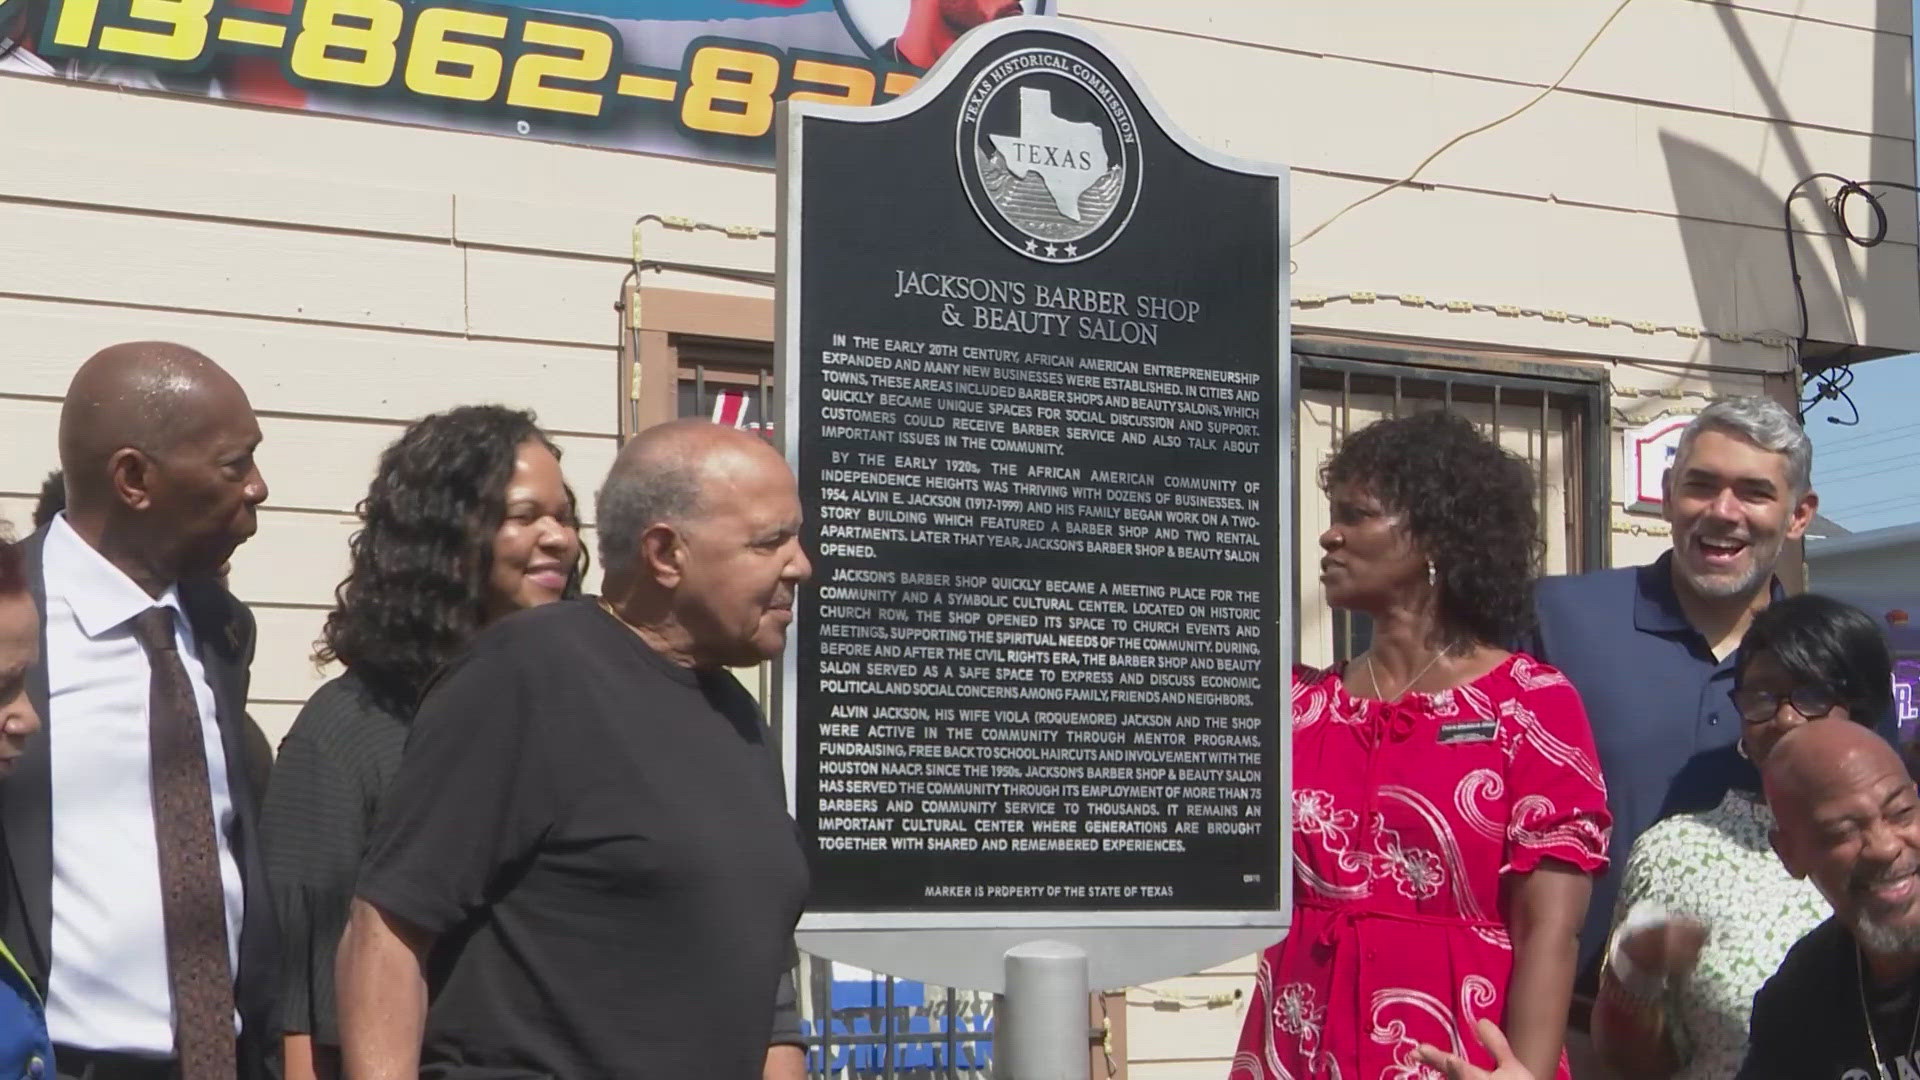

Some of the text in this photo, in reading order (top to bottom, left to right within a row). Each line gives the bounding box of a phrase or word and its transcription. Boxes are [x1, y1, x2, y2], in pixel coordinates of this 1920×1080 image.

[965, 54, 1135, 144] TEXAS HISTORICAL COMMISSION
[1012, 142, 1092, 171] TEXAS
[895, 270, 1200, 323] JACKSON'S BARBER SHOP
[941, 303, 1158, 346] & BEAUTY SALON
[832, 333, 846, 348] IN
[853, 335, 879, 351] THE
[884, 338, 924, 355] EARLY
[928, 342, 958, 358] 20TH
[1025, 351, 1074, 368] AFRICAN
[1079, 357, 1138, 374] AMERICAN
[1143, 363, 1259, 384] ENTREPRENEURSHIP
[822, 351, 892, 370] EXPANDED
[894, 358, 921, 372] AND
[923, 360, 959, 376] MANY
[962, 364, 990, 378] NEW
[993, 367, 1063, 385] BUSINESSES
[1066, 373, 1100, 388] WERE
[1185, 384, 1197, 397] IN
[1199, 386, 1233, 400] CITIES
[1236, 389, 1259, 402] AND
[821, 406, 1258, 453] CUSTOMERS COULD RECEIVE BARBER SERVICE AND ALSO TALK ABOUT
[821, 425, 893, 443] IMPORTANT
[898, 431, 940, 447] ISSUES
[944, 435, 957, 448] IN
[962, 436, 986, 450] THE
[831, 450, 849, 465] BY
[859, 452, 885, 467] THE
[894, 455, 937, 471] EARLY
[991, 462, 1017, 476] THE
[1027, 465, 1081, 481] AFRICAN
[1090, 469, 1154, 486] AMERICAN
[1164, 475, 1236, 492] COMMUNITY
[1244, 480, 1260, 493] OF
[821, 469, 921, 488] INDEPENDENCE
[925, 476, 979, 492] HEIGHTS
[983, 480, 1008, 494] WAS
[1014, 482, 1067, 498] THRIVING
[1072, 486, 1102, 500] WITH
[1106, 489, 1151, 503] DOZENS
[1155, 492, 1170, 505] OF
[1248, 498, 1259, 510] IN
[832, 569, 1260, 602] JACKSON'S BARBER SHOP QUICKLY BECAME A MEETING PLACE FOR THE
[819, 605, 871, 620] CHURCH
[917, 610, 941, 623] THE
[948, 612, 980, 625] SHOP
[986, 613, 1038, 627] OPENED
[1044, 616, 1062, 628] ITS
[1068, 617, 1105, 630] SPACE
[1113, 619, 1127, 631] TO
[1133, 620, 1179, 634] CHURCH
[1185, 623, 1230, 636] EVENTS
[1236, 625, 1260, 637] AND
[819, 661, 860, 675] SALON
[866, 663, 917, 677] SERVED
[923, 665, 938, 678] AS
[944, 665, 953, 678] A
[959, 666, 990, 680] SAFE
[995, 667, 1033, 681] SPACE
[1040, 669, 1055, 682] TO
[1061, 670, 1113, 684] EXPRESS
[1119, 672, 1144, 685] AND
[1149, 673, 1195, 686] DISCUSS
[831, 705, 868, 719] ALVIN
[934, 708, 954, 722] HIS
[959, 709, 990, 723] WIFE
[994, 710, 1029, 724] VIOLA
[1034, 711, 1117, 726] (ROQUEMORE)
[1122, 714, 1171, 728] JACKSON
[1176, 715, 1200, 728] AND
[1206, 716, 1227, 729] THE
[1231, 717, 1261, 730] SHOP
[819, 723, 859, 737] WERE
[868, 725, 915, 739] ACTIVE
[924, 726, 938, 739] IN
[947, 727, 972, 740] THE
[981, 728, 1057, 742] COMMUNITY
[1067, 731, 1125, 744] THROUGH
[1133, 732, 1185, 746] MENTOR
[818, 780, 1261, 799] HAS SERVED THE COMMUNITY THROUGH ITS EMPLOYMENT OF MORE THAN 75
[818, 799, 878, 813] BARBERS
[886, 800, 913, 813] AND
[921, 801, 996, 814] COMMUNITY
[1004, 802, 1055, 815] SERVICE
[1065, 803, 1079, 815] TO
[1167, 804, 1177, 816] IT
[1186, 804, 1238, 816] REMAINS
[1245, 805, 1261, 816] AN
[818, 818, 1260, 834] IMPORTANT CULTURAL CENTER WHERE GENERATIONS ARE BROUGHT
[819, 838, 887, 851] TOGETHER
[891, 838, 923, 851] WITH
[927, 838, 977, 851] SHARED
[982, 838, 1007, 851] AND
[1011, 839, 1098, 851] REMEMBERED
[924, 886, 1173, 897] MARKER IS PROPERTY OF THE STATE OF TEXAS
